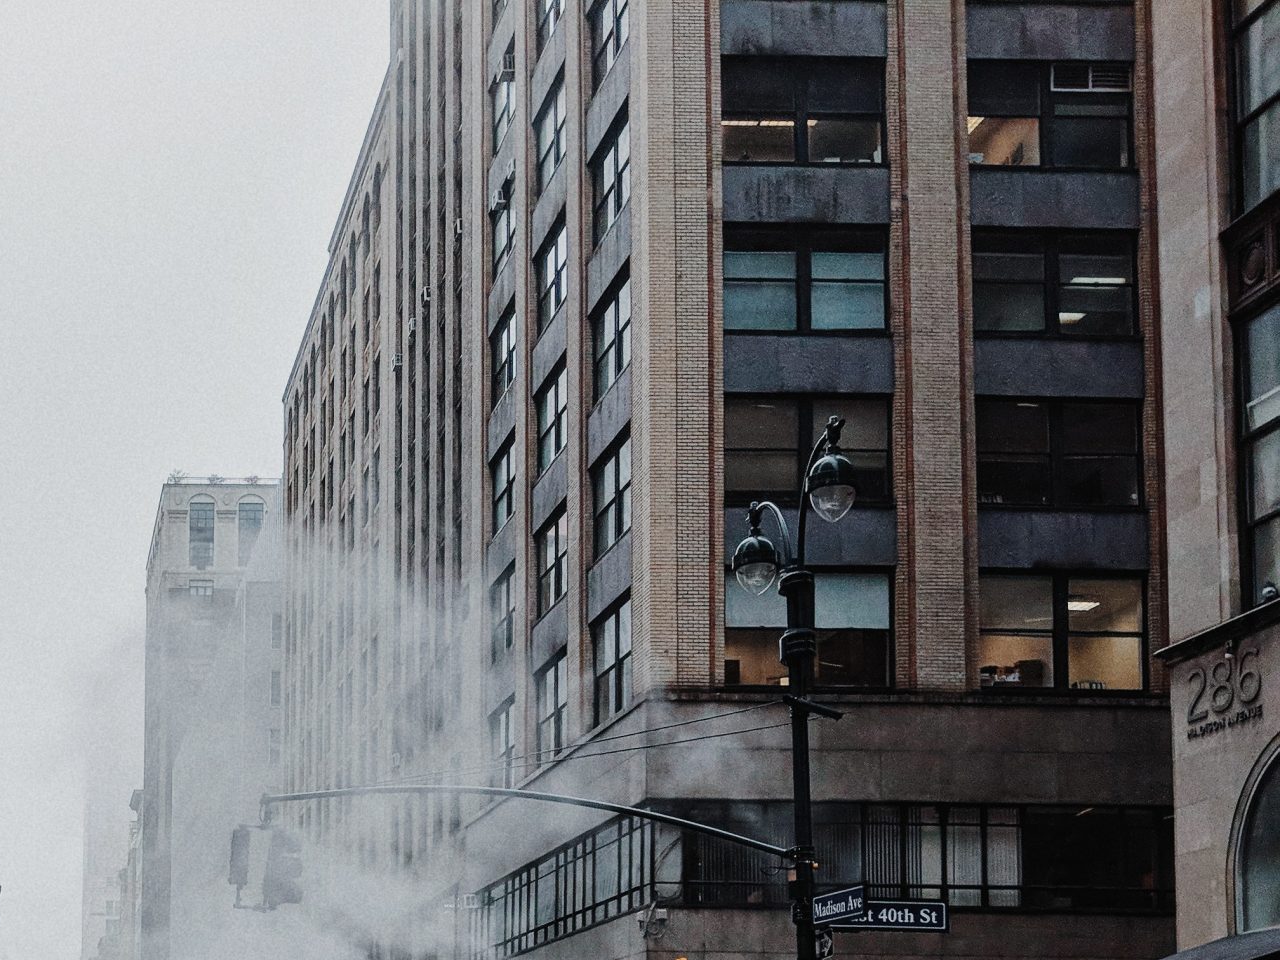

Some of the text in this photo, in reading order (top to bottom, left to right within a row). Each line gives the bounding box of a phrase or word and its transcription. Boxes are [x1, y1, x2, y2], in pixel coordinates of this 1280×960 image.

[1187, 648, 1262, 724] 286
[814, 895, 863, 919] Madison Ave
[878, 908, 915, 923] 40th
[919, 908, 938, 924] St
